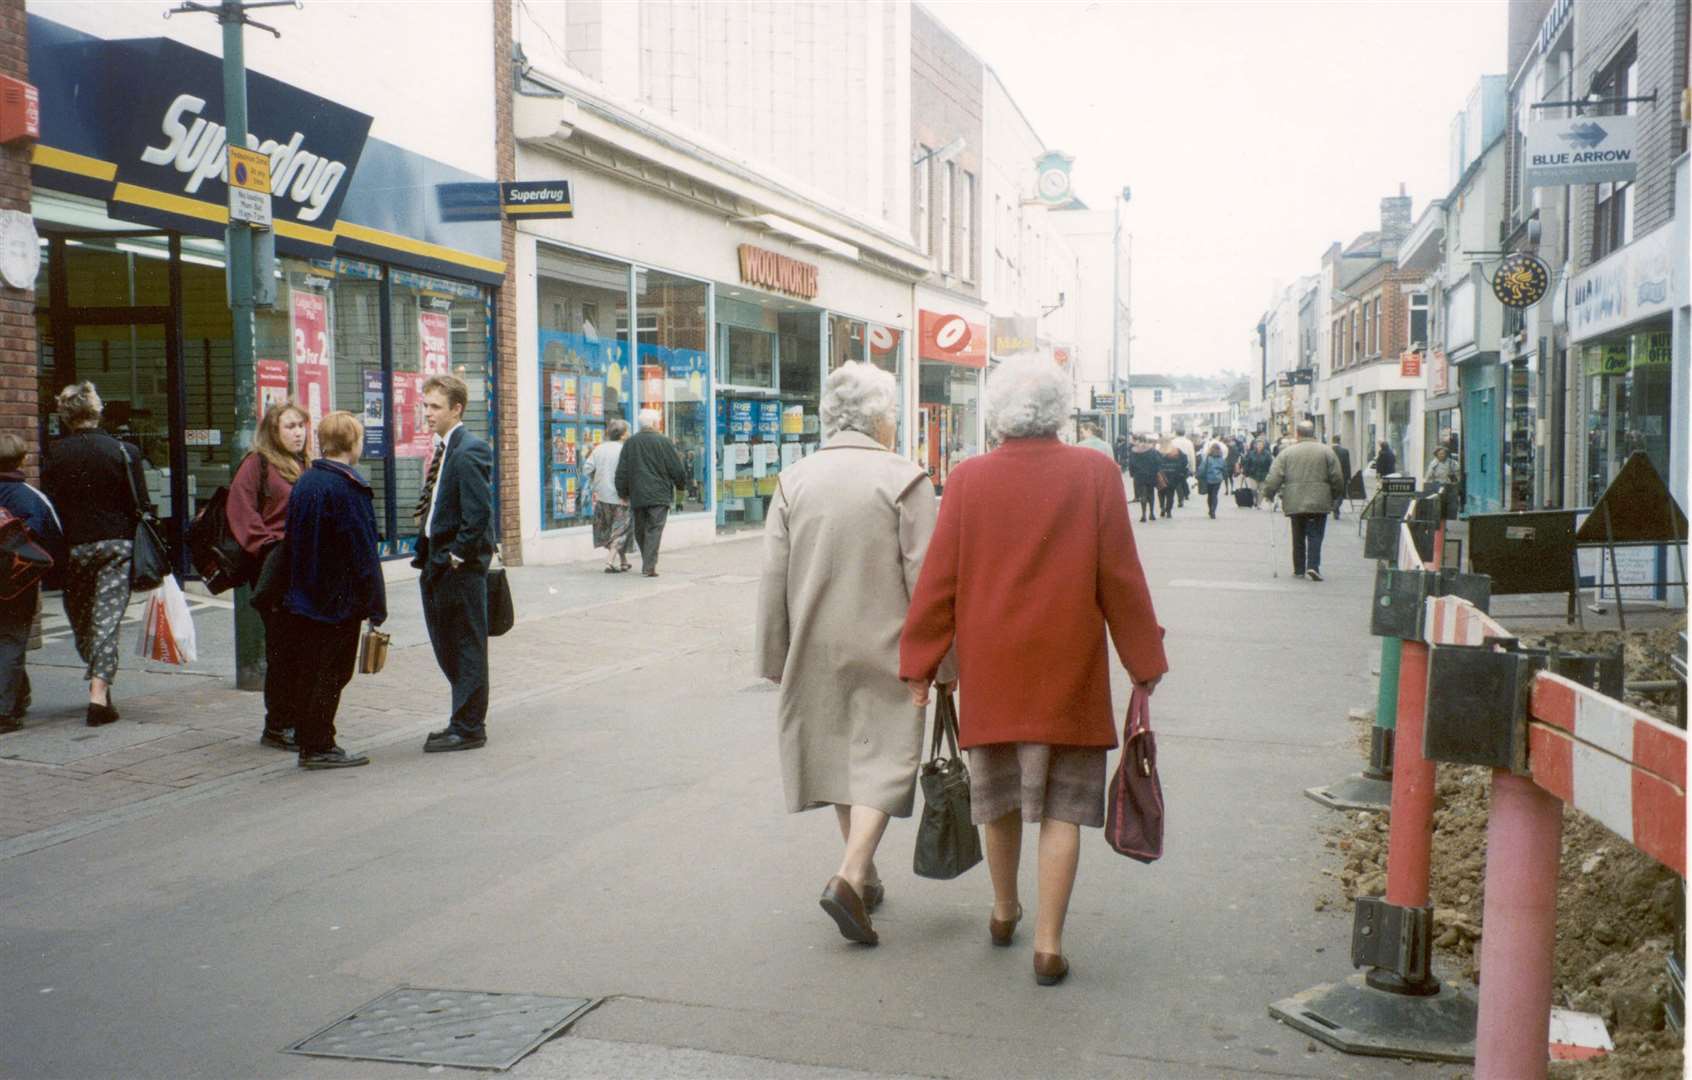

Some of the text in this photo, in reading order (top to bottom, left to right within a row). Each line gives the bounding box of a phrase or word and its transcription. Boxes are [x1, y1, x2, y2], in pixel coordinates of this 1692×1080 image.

[1533, 149, 1631, 165] BLUE ARROW
[509, 188, 563, 202] Superdrug
[738, 244, 819, 300] WOOLWORTHS
[295, 328, 330, 366] 3 for 2
